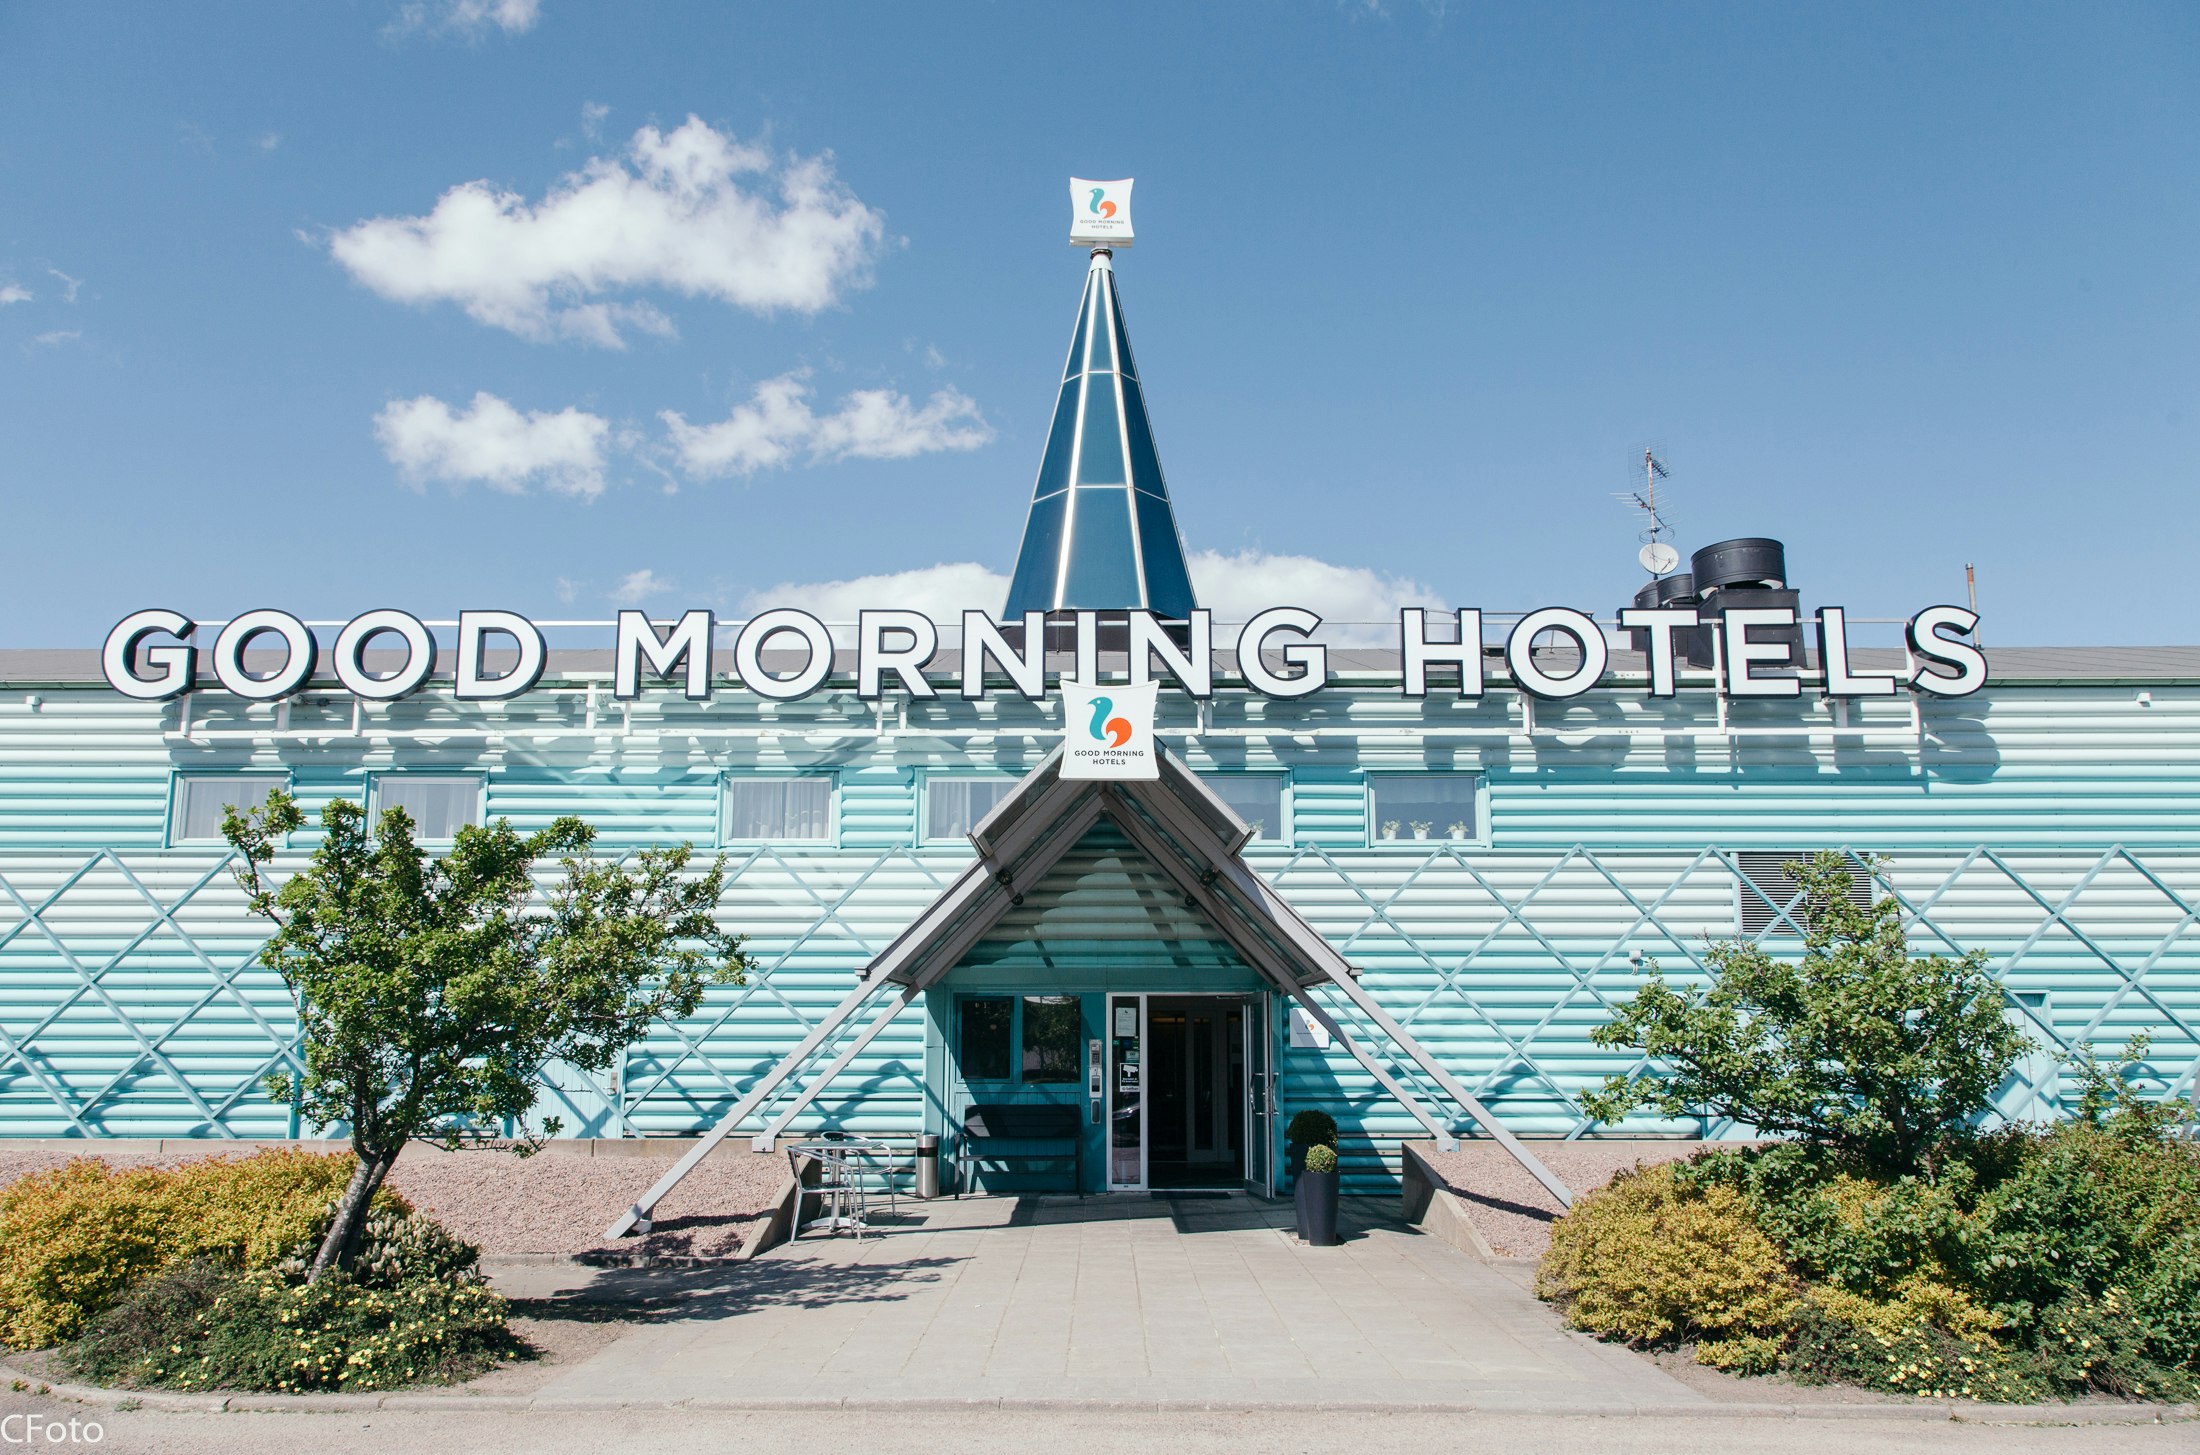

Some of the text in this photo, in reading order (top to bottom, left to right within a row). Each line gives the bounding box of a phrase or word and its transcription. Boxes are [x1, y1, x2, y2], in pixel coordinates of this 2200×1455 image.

[101, 604, 1988, 700] GOOD MORNING HOTELS
